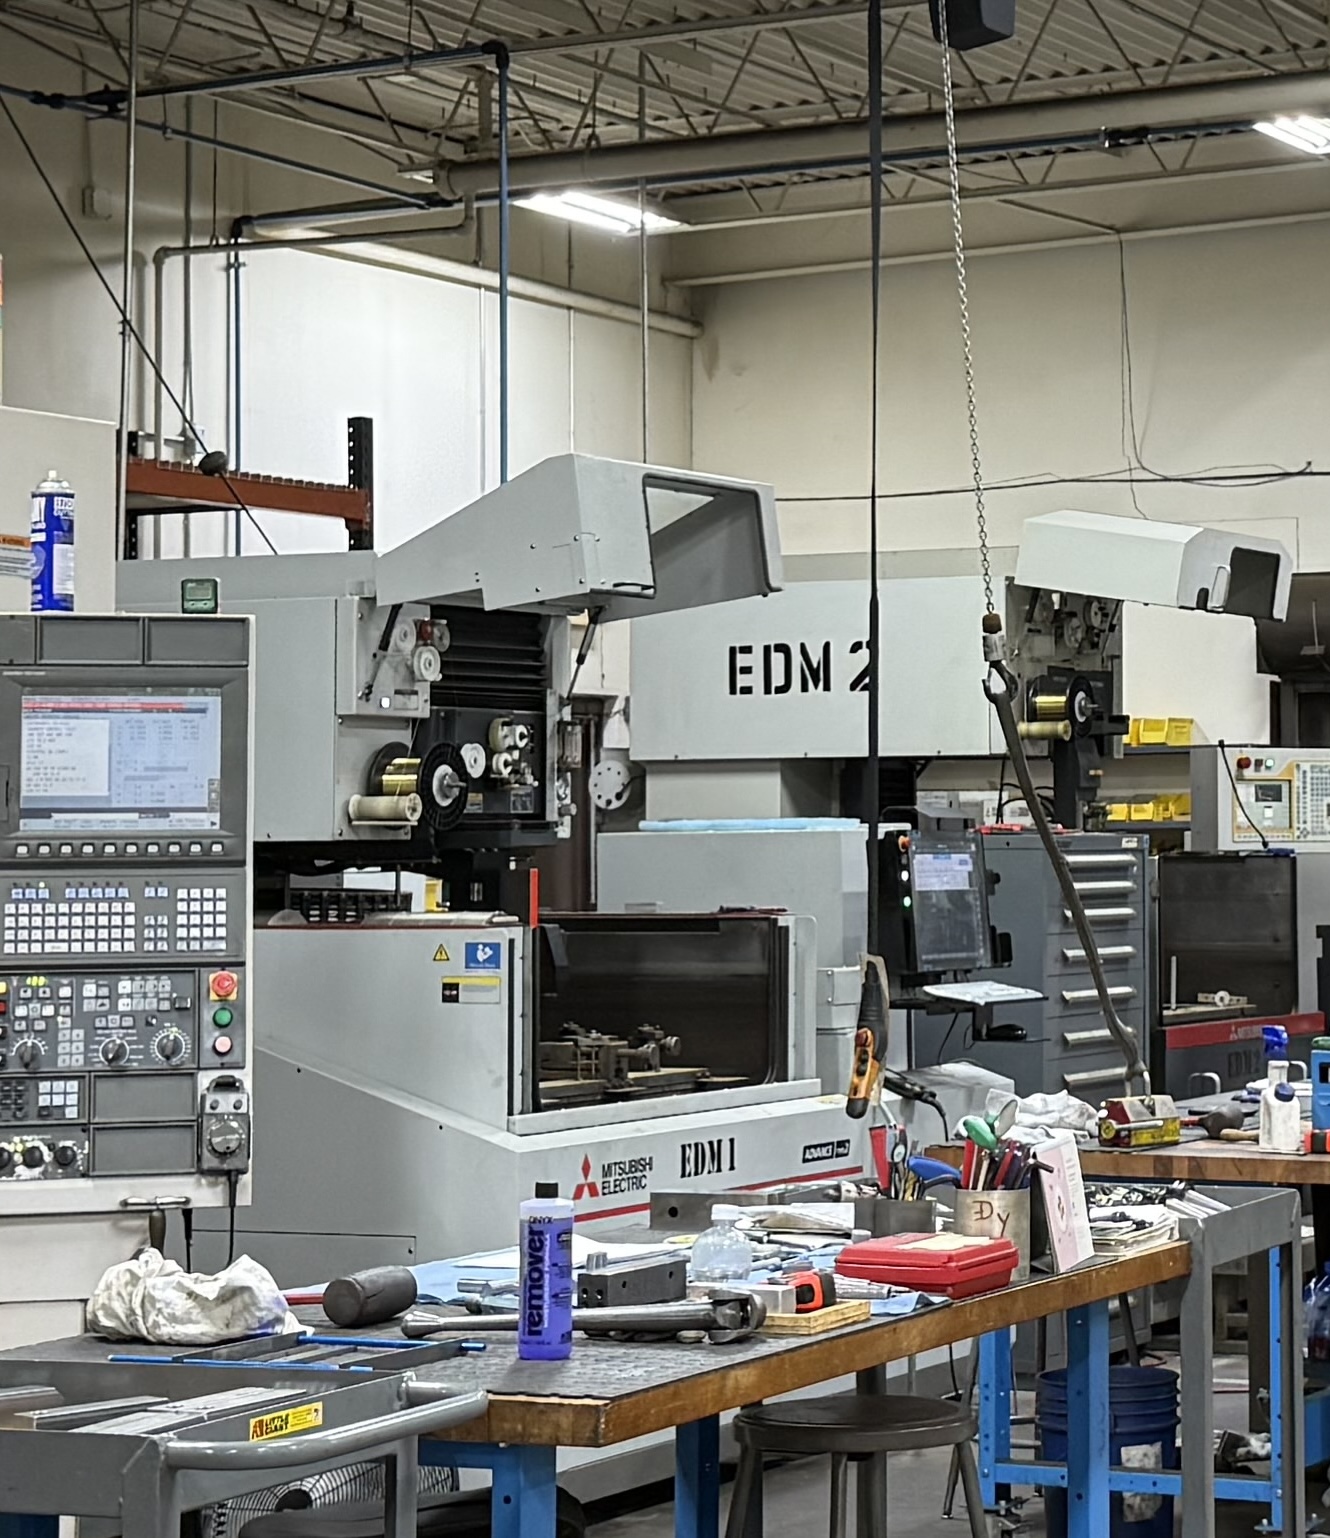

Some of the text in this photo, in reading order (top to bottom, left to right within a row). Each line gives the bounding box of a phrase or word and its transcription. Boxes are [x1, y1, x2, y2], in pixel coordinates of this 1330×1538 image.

[729, 641, 831, 696] EDM
[601, 1156, 653, 1180] MITSUBISHI
[680, 1137, 736, 1179] EDM 1
[601, 1175, 648, 1197] ELECTRIC
[527, 1224, 545, 1337] remover
